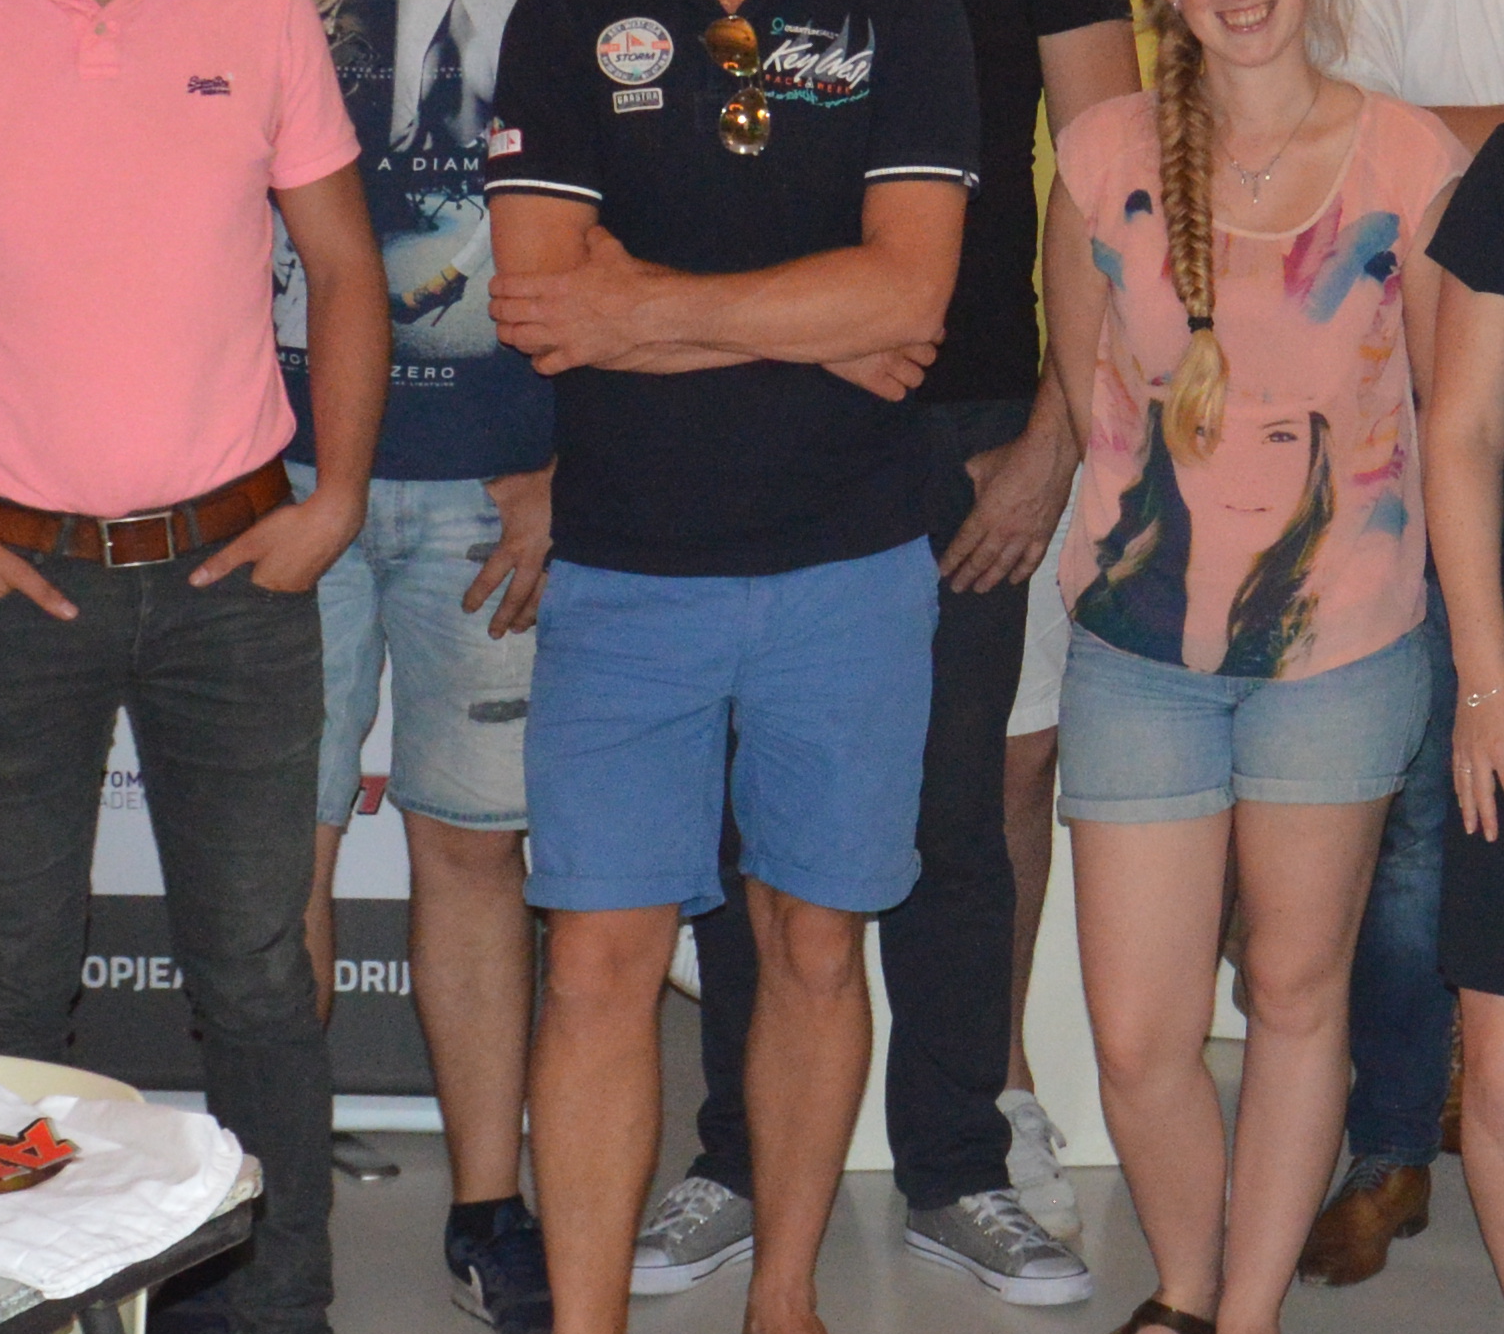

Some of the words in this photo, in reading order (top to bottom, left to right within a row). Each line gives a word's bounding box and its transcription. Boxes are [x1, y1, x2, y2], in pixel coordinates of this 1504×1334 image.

[615, 52, 656, 63] STORM
[377, 157, 392, 172] A
[412, 156, 480, 172] DIAM
[390, 365, 456, 380] ZERO
